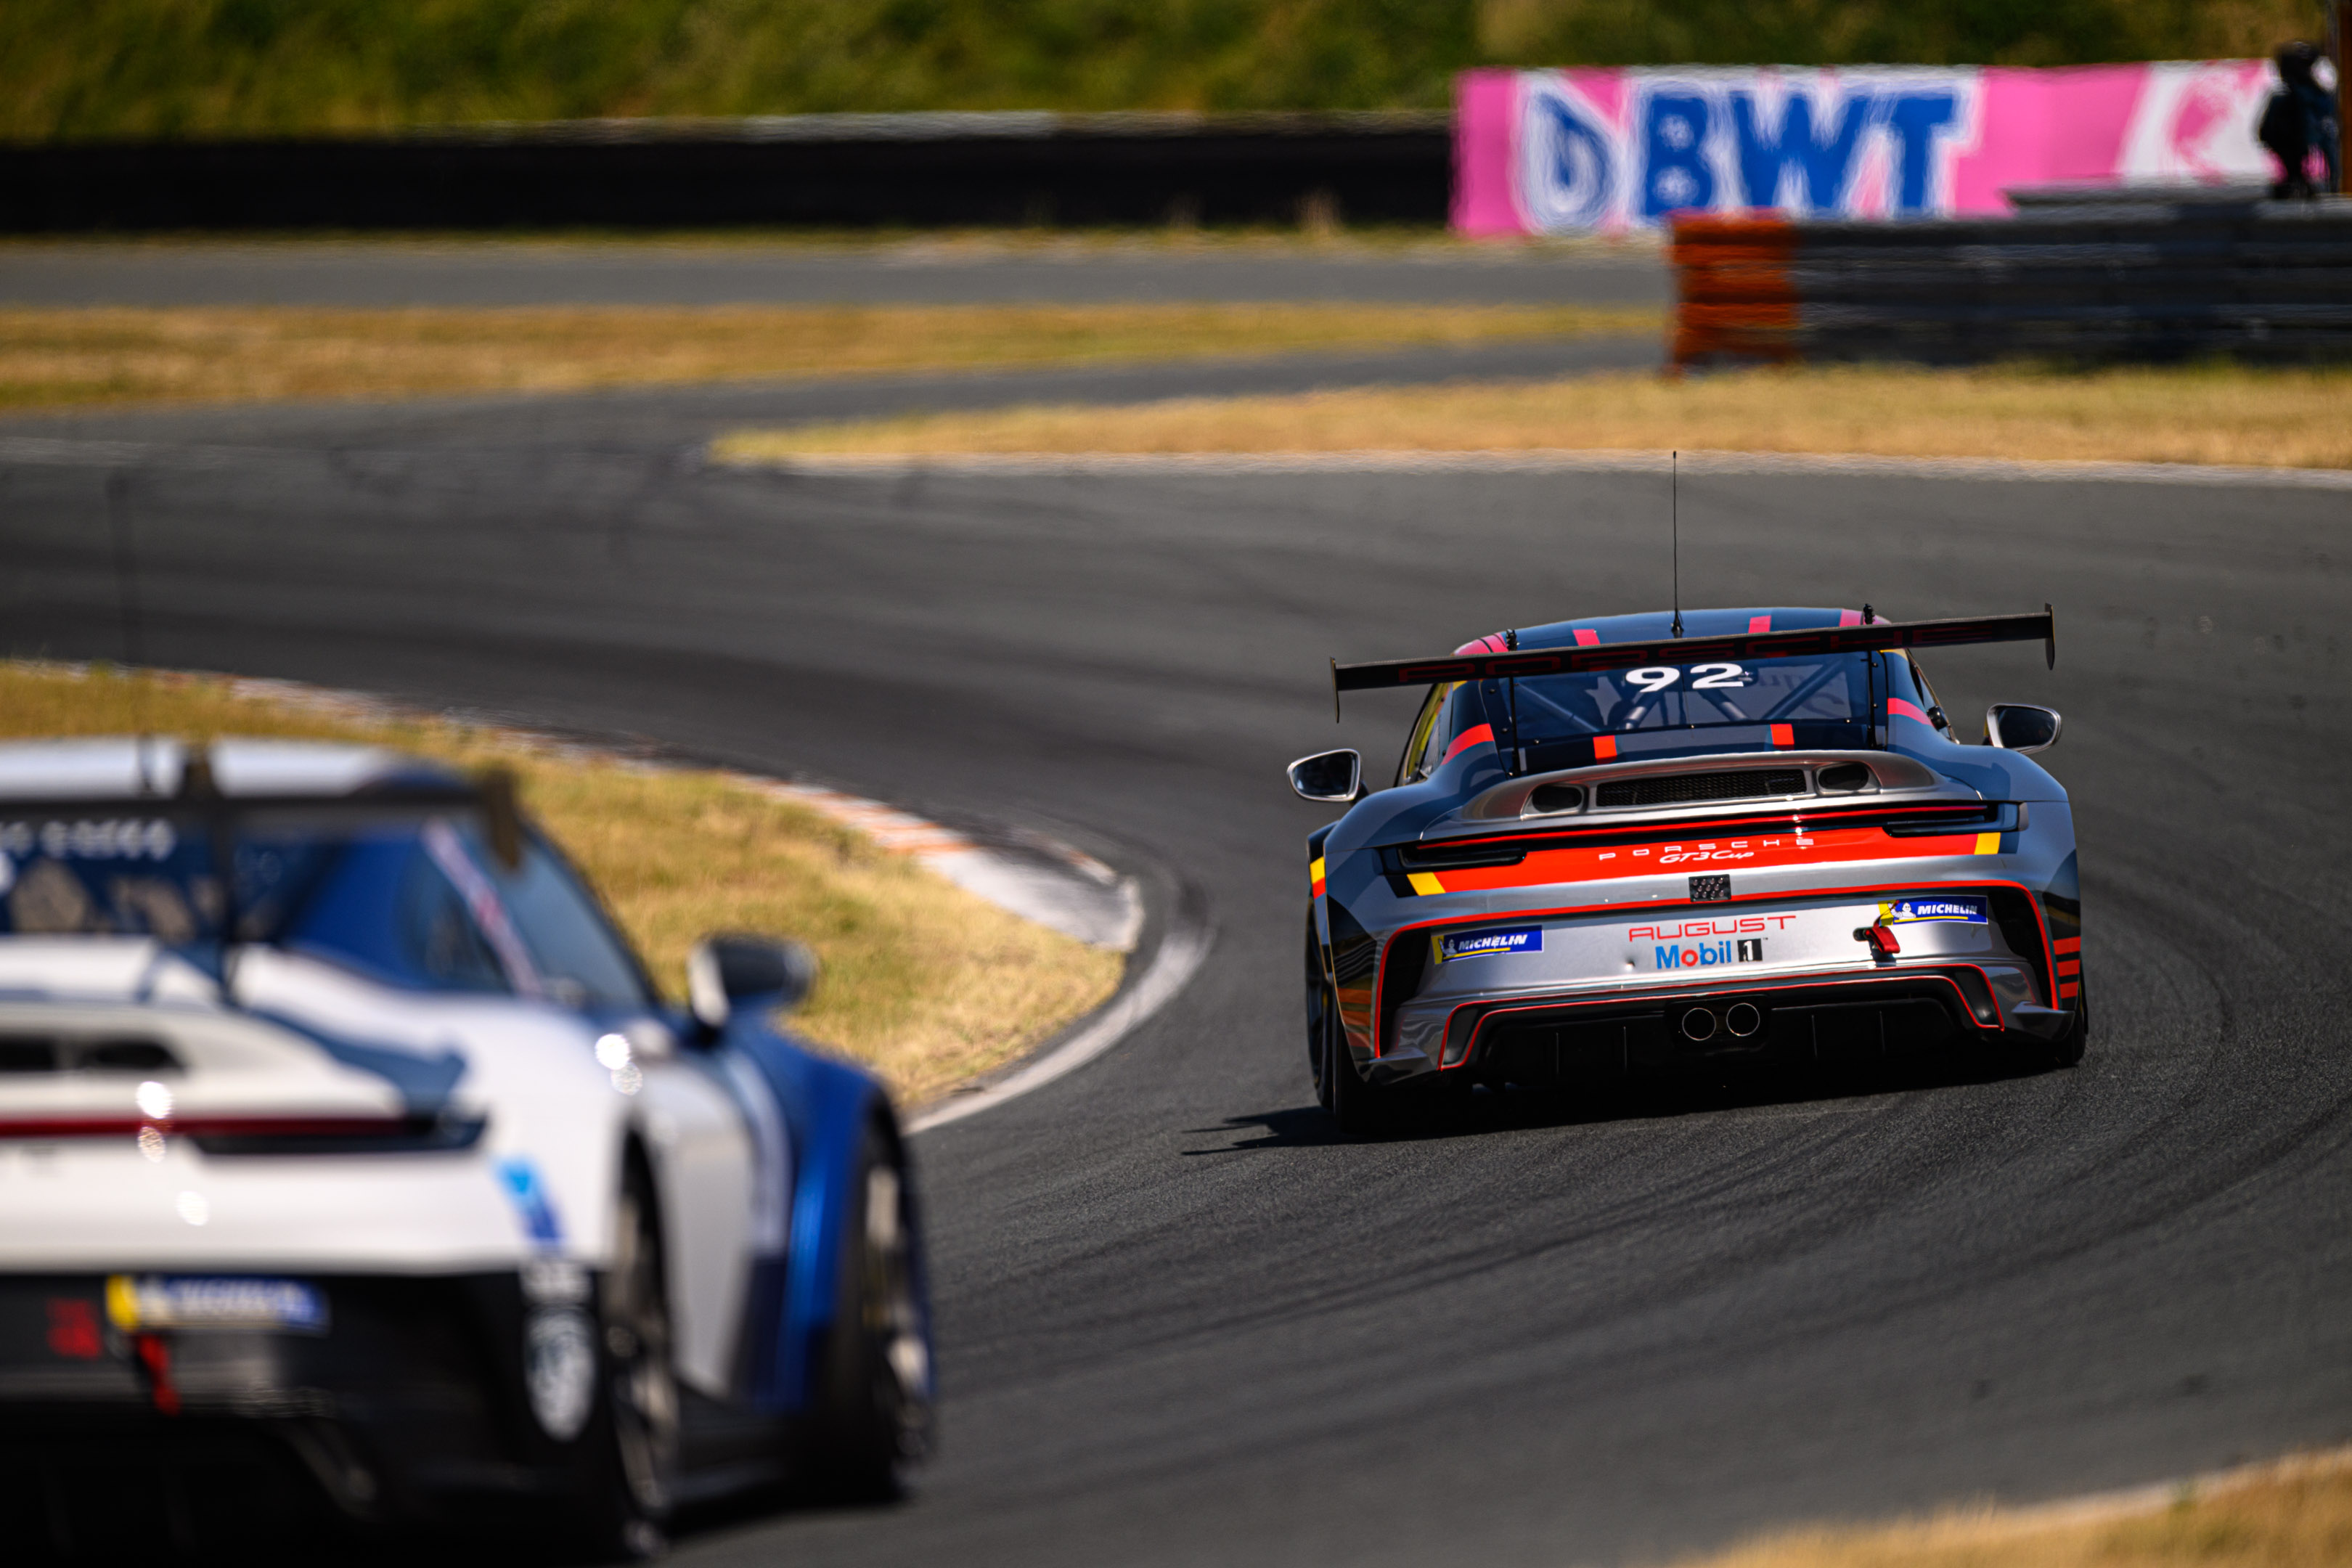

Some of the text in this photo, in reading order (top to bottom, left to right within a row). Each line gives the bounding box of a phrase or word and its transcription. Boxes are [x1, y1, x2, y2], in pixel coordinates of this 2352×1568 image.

[1637, 86, 1967, 218] BWT
[1399, 625, 1993, 682] PORSCHE
[1625, 663, 1744, 693] 92
[1598, 838, 1814, 860] PORSCHE
[1659, 849, 1755, 863] GT3 Cup
[1917, 904, 1977, 915] MICHELIN
[1629, 915, 1797, 942] AUGUST
[1458, 934, 1528, 951] MICHELIN
[1655, 940, 1732, 969] Mobil
